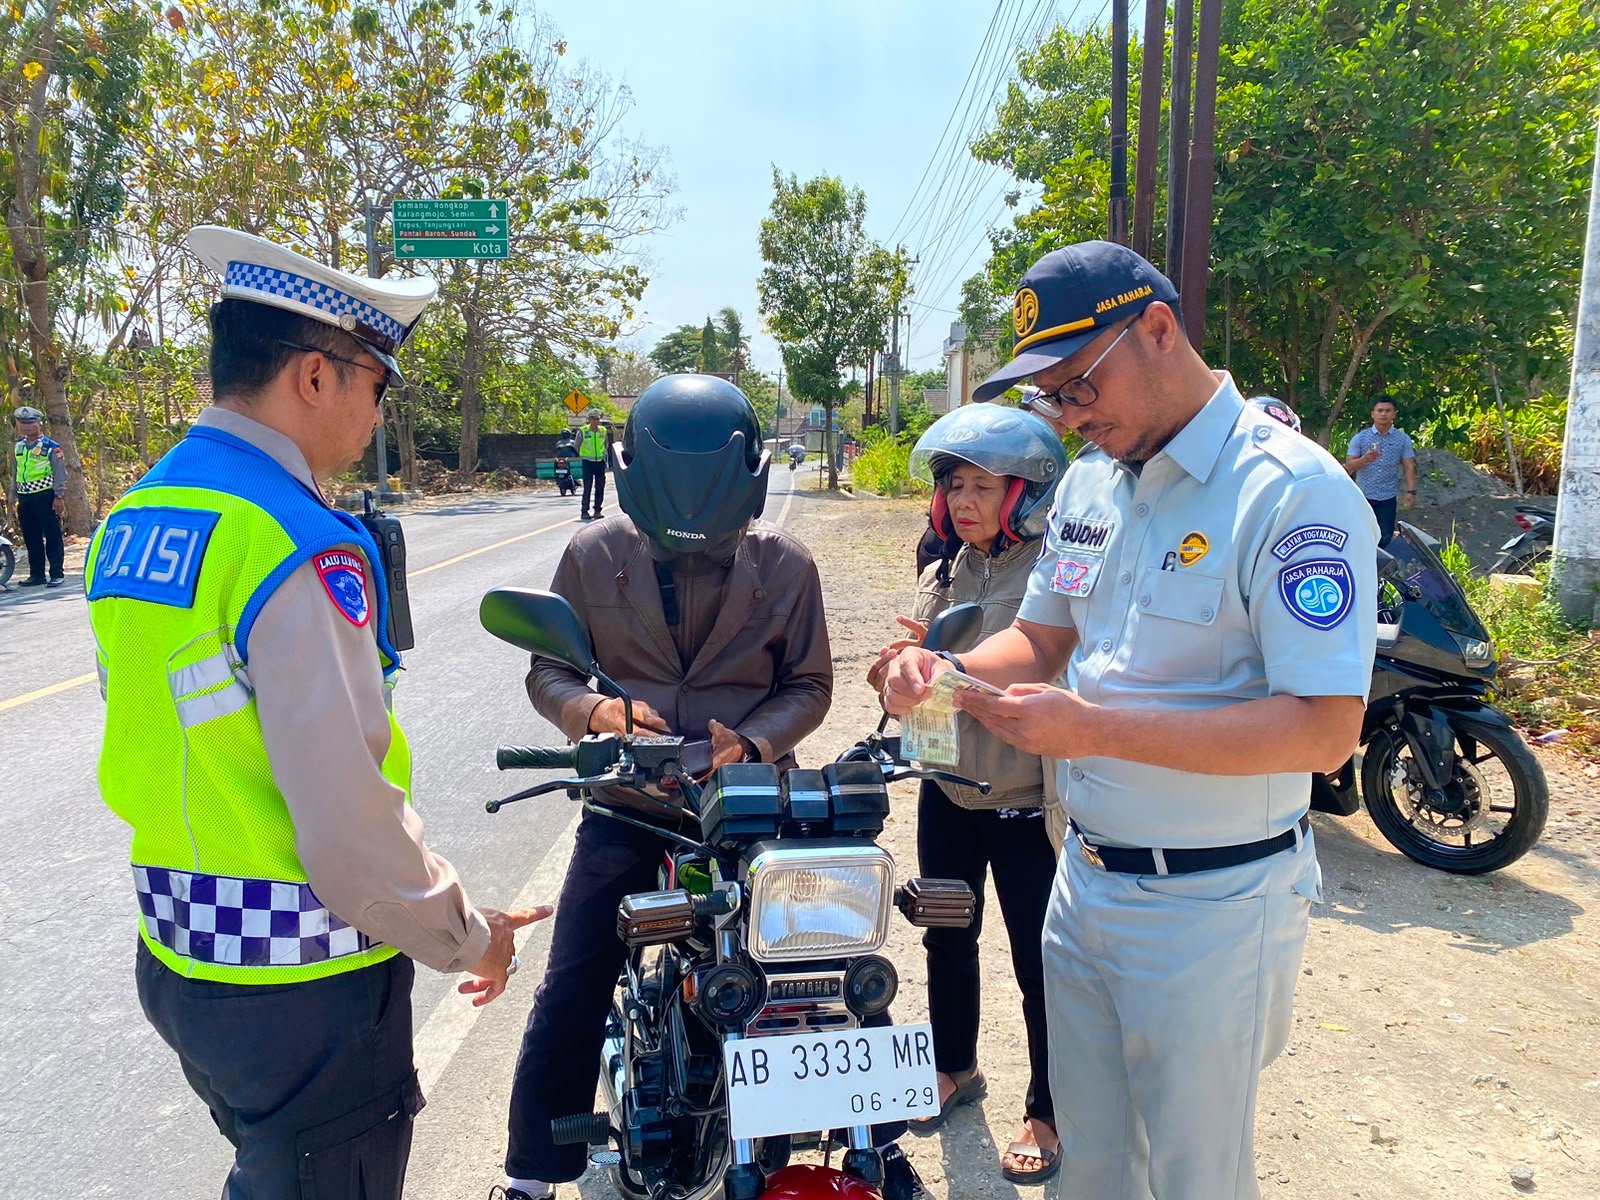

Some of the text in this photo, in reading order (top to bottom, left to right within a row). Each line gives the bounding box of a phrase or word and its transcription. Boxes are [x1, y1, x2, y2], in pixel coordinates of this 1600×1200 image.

[434, 202, 469, 210] Rongkop
[424, 222, 466, 230] Tanjungsari
[473, 242, 502, 254] Kota
[1095, 284, 1154, 313] JASA RAHARJA
[666, 528, 706, 540] HONDA
[1060, 522, 1109, 547] BUDHI
[1279, 529, 1342, 555] WILAYAH YOGYAKARTA
[95, 522, 199, 586] POISI
[319, 554, 340, 571] LALU
[1285, 565, 1344, 585] JASA RAHARJA
[780, 980, 830, 997] YAMAHA
[730, 1031, 932, 1088] AB 3333 MR
